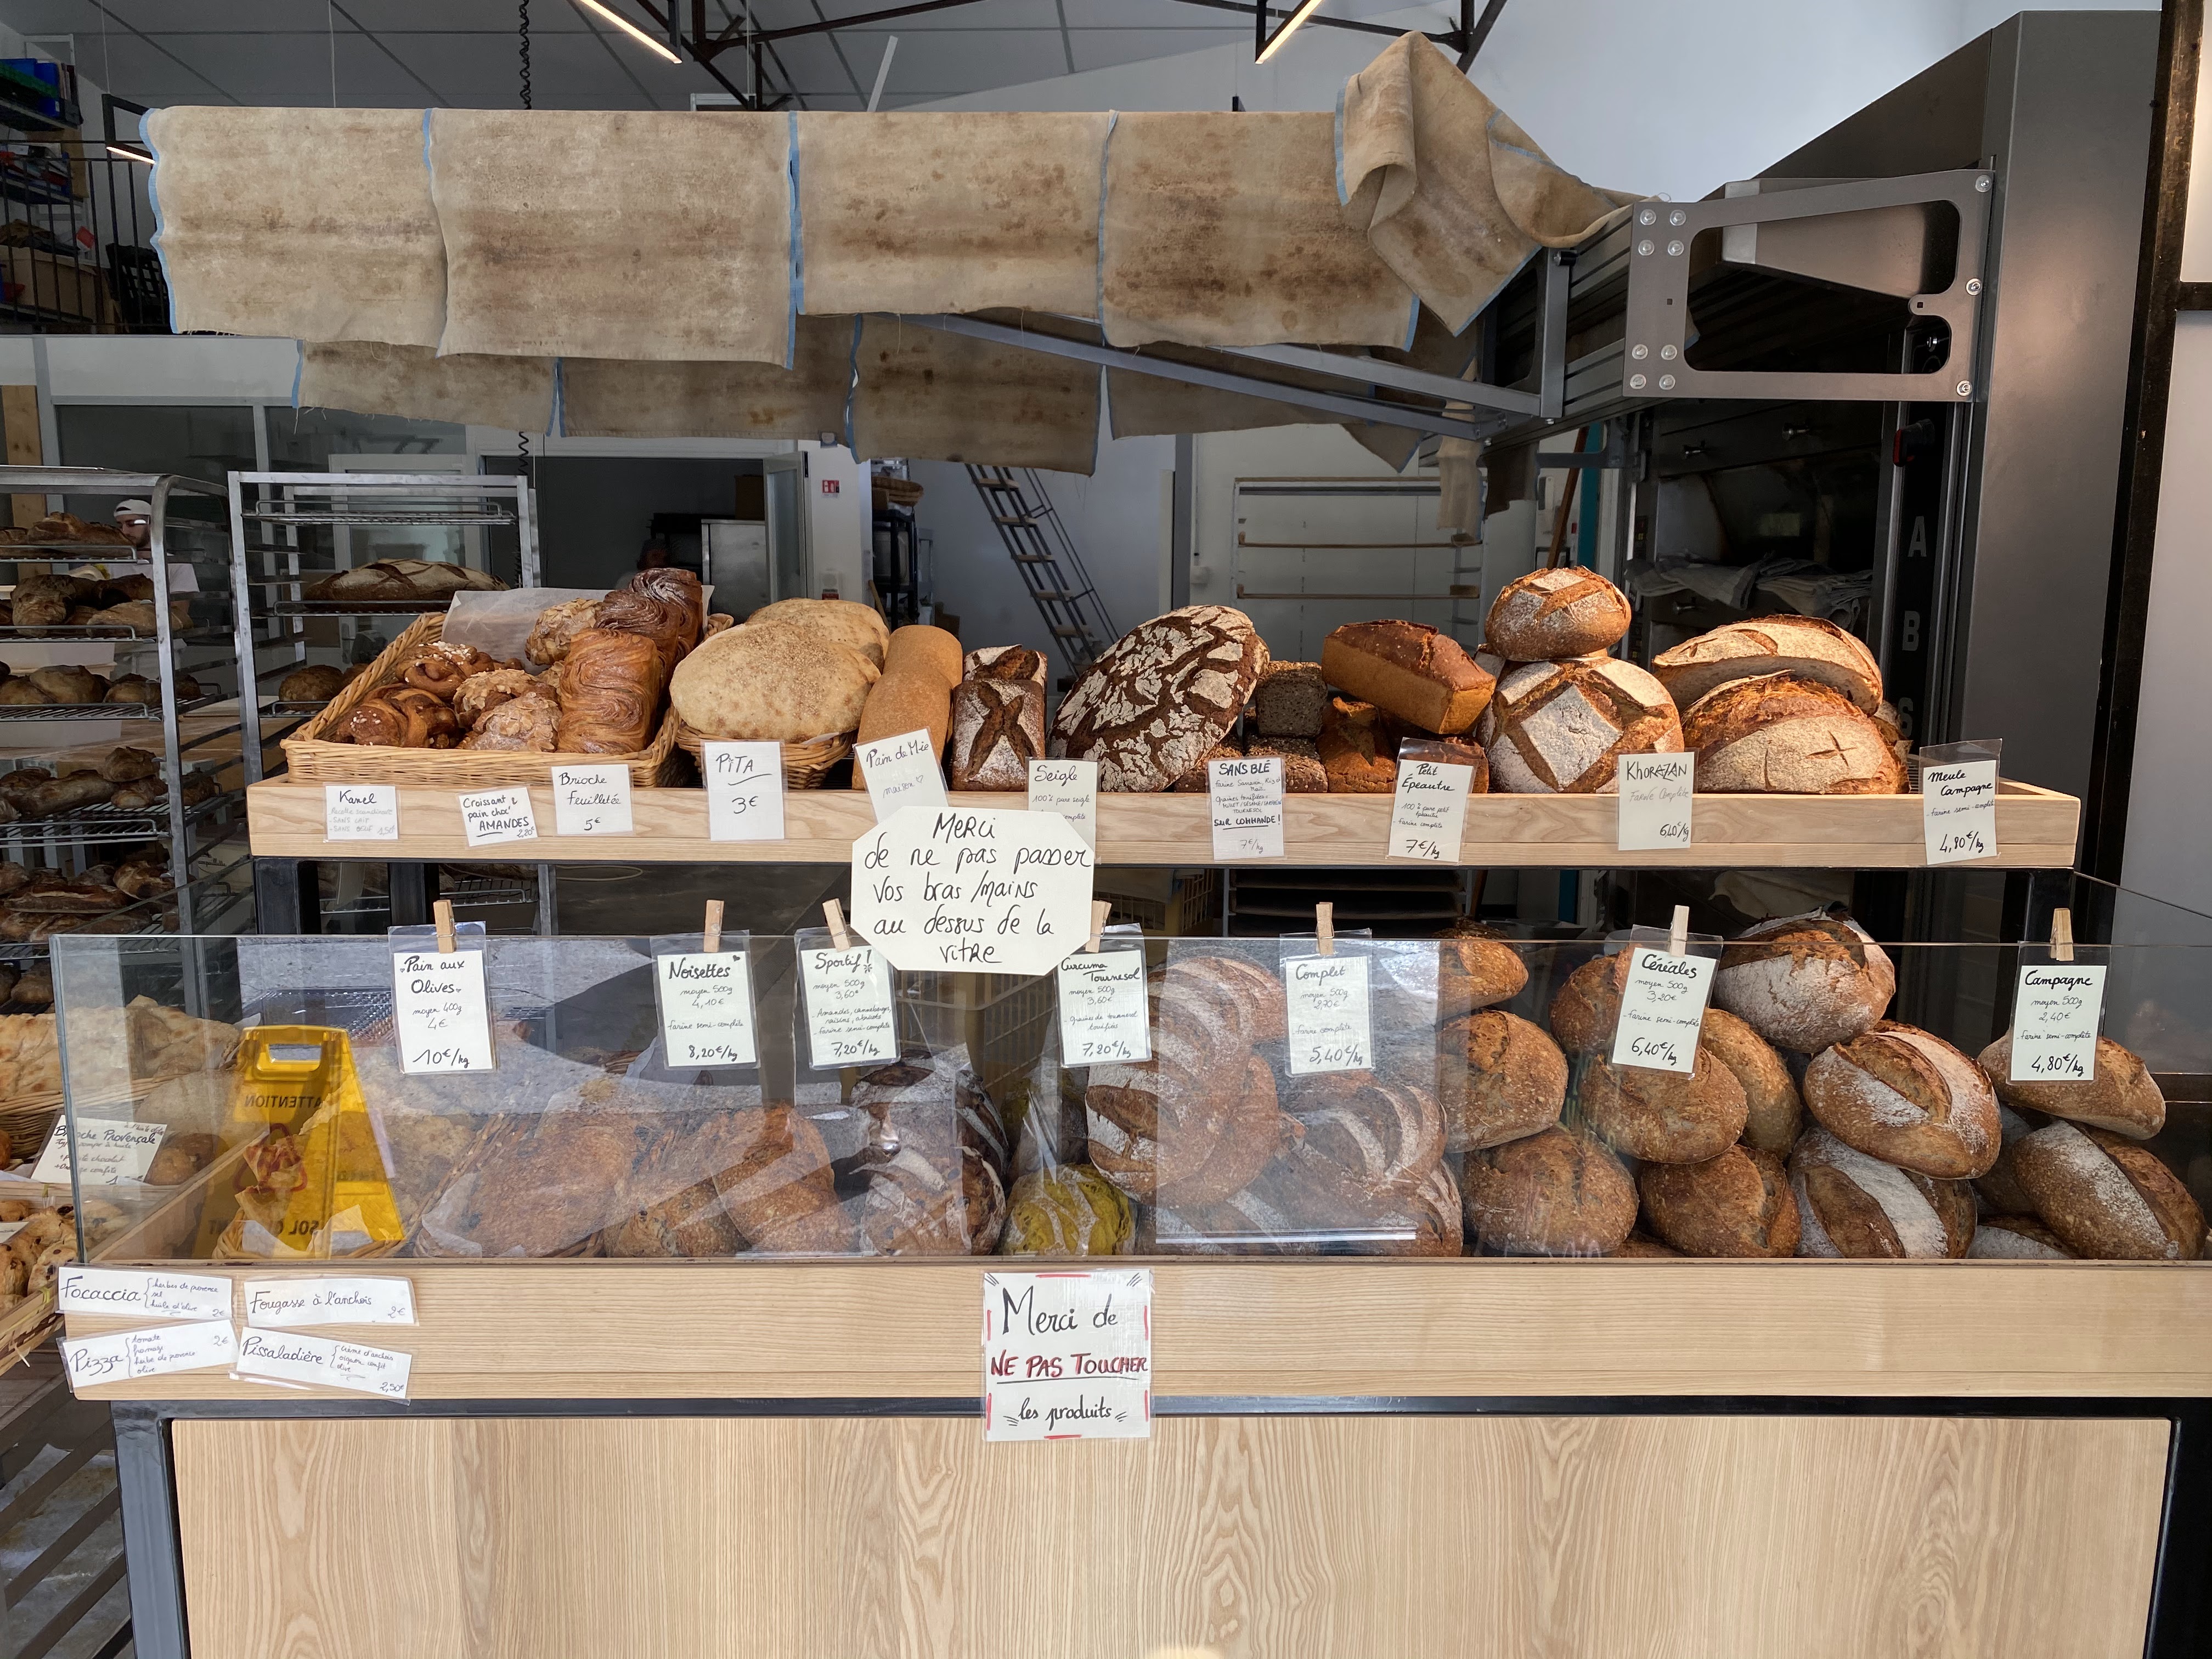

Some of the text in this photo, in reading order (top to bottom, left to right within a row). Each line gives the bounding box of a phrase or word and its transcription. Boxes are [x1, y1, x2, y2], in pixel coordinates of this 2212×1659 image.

[866, 740, 929, 768] Pain de Mie
[1218, 760, 1271, 776] SANS BLÉ
[1416, 763, 1438, 776] Petit
[558, 772, 607, 786] Brioche
[1034, 765, 1077, 787] Seigle
[1402, 774, 1455, 793] Épeautre
[1927, 770, 1966, 782] Meule
[340, 790, 377, 804] Kanel
[883, 782, 915, 798] maison
[1941, 783, 1993, 797] Campagne
[463, 795, 506, 808] Croissant
[1056, 797, 1070, 806] pure
[1073, 794, 1090, 806] seigle
[467, 810, 488, 822] pain
[479, 816, 529, 831] AMANDES
[865, 832, 889, 869] de
[910, 848, 941, 866] ne
[956, 848, 997, 874] pas
[874, 904, 1054, 935] au dessus de la
[404, 955, 465, 972] Pain aux
[669, 957, 731, 979] Noisettes
[1061, 957, 1108, 971] Curcuma
[1641, 953, 1697, 979] Céréales
[1083, 967, 1141, 982] Tournesol
[1296, 963, 1346, 986] Complet
[2025, 969, 2094, 991] Campagne
[411, 979, 455, 994] Olives
[680, 985, 733, 998] moyen 500g
[812, 983, 840, 992] moyen
[1069, 985, 1115, 998] moyen 500g
[1635, 979, 1689, 994] moyen 500g
[1300, 988, 1348, 1002] moyen 500g
[2030, 995, 2083, 1009] moyen 500g
[412, 1008, 440, 1018] moyen
[1628, 1009, 1652, 1021] farine
[667, 1019, 692, 1030] farine
[818, 1026, 843, 1035] farine
[104, 1129, 156, 1146] Provençale
[60, 1275, 142, 1301] Focaccia
[152, 1278, 177, 1289] herbes
[149, 1300, 170, 1310] huile
[250, 1290, 372, 1315] Fougasse à l'anchois
[1002, 1285, 1119, 1336] Merci de
[131, 1334, 161, 1344] tomate
[242, 1336, 324, 1365] Pissaladière
[70, 1348, 124, 1376] Pizza
[991, 1349, 1019, 1376] NE
[1026, 1355, 1063, 1378] PAS
[137, 1366, 156, 1374] olive
[1018, 1394, 1113, 1431] les produits
